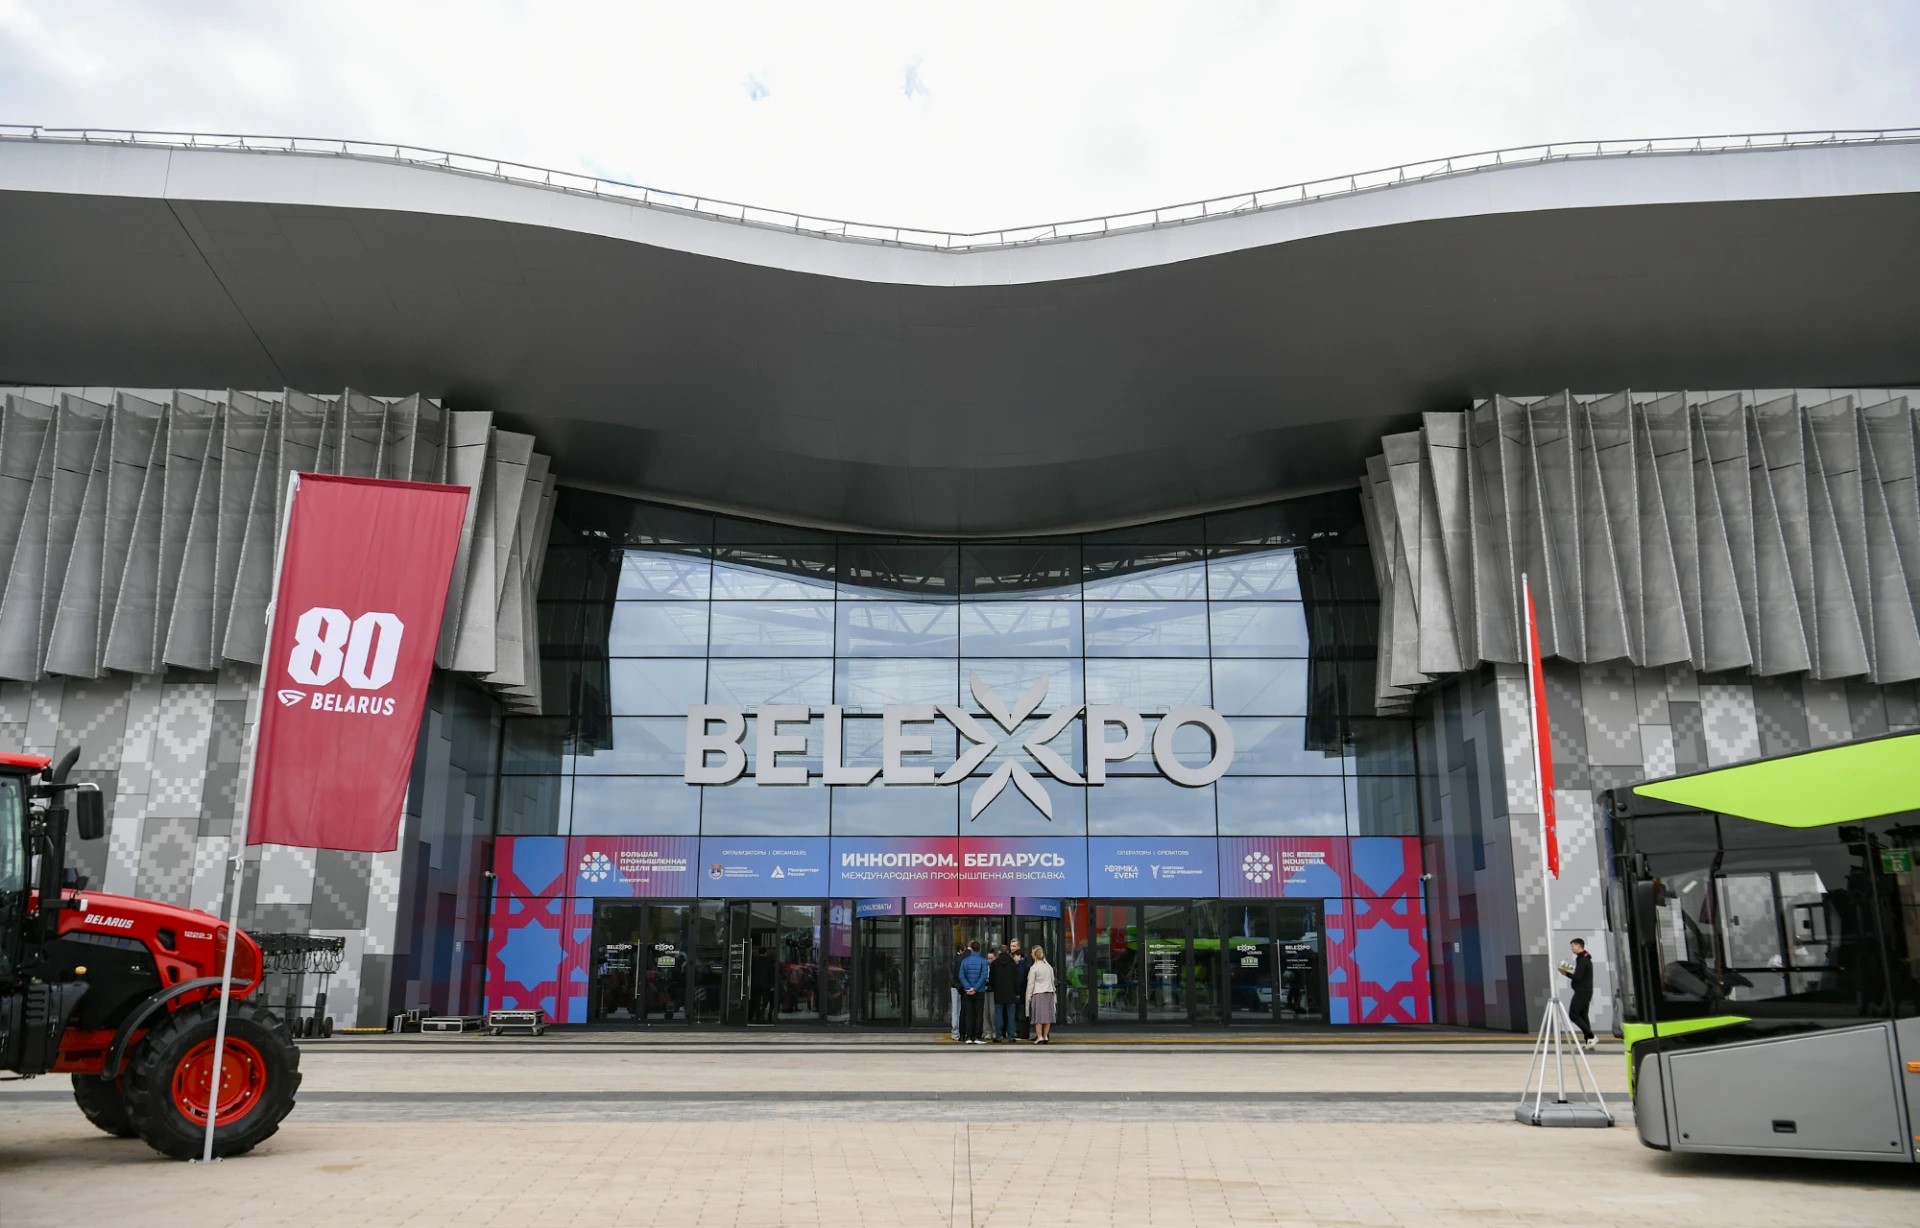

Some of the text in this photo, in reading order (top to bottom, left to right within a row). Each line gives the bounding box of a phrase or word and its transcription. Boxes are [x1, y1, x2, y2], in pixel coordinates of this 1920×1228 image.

[287, 606, 405, 690] 80
[310, 692, 396, 716] BELARUS
[683, 672, 1235, 822] BELEXPO
[841, 853, 1066, 867] ИННОПРОМ. БЕЛАРУСЬ
[841, 871, 1066, 880] МЕЖДУНАРОДНАЯ ПРОМЫШЛЕННАЯ ВЫСТАВКА
[913, 901, 1004, 909] САРДЭЧНА ЗАПРАШАЕМ!
[84, 913, 134, 929] BELARUS
[655, 943, 675, 951] EXPO
[1237, 944, 1257, 952] EXPO
